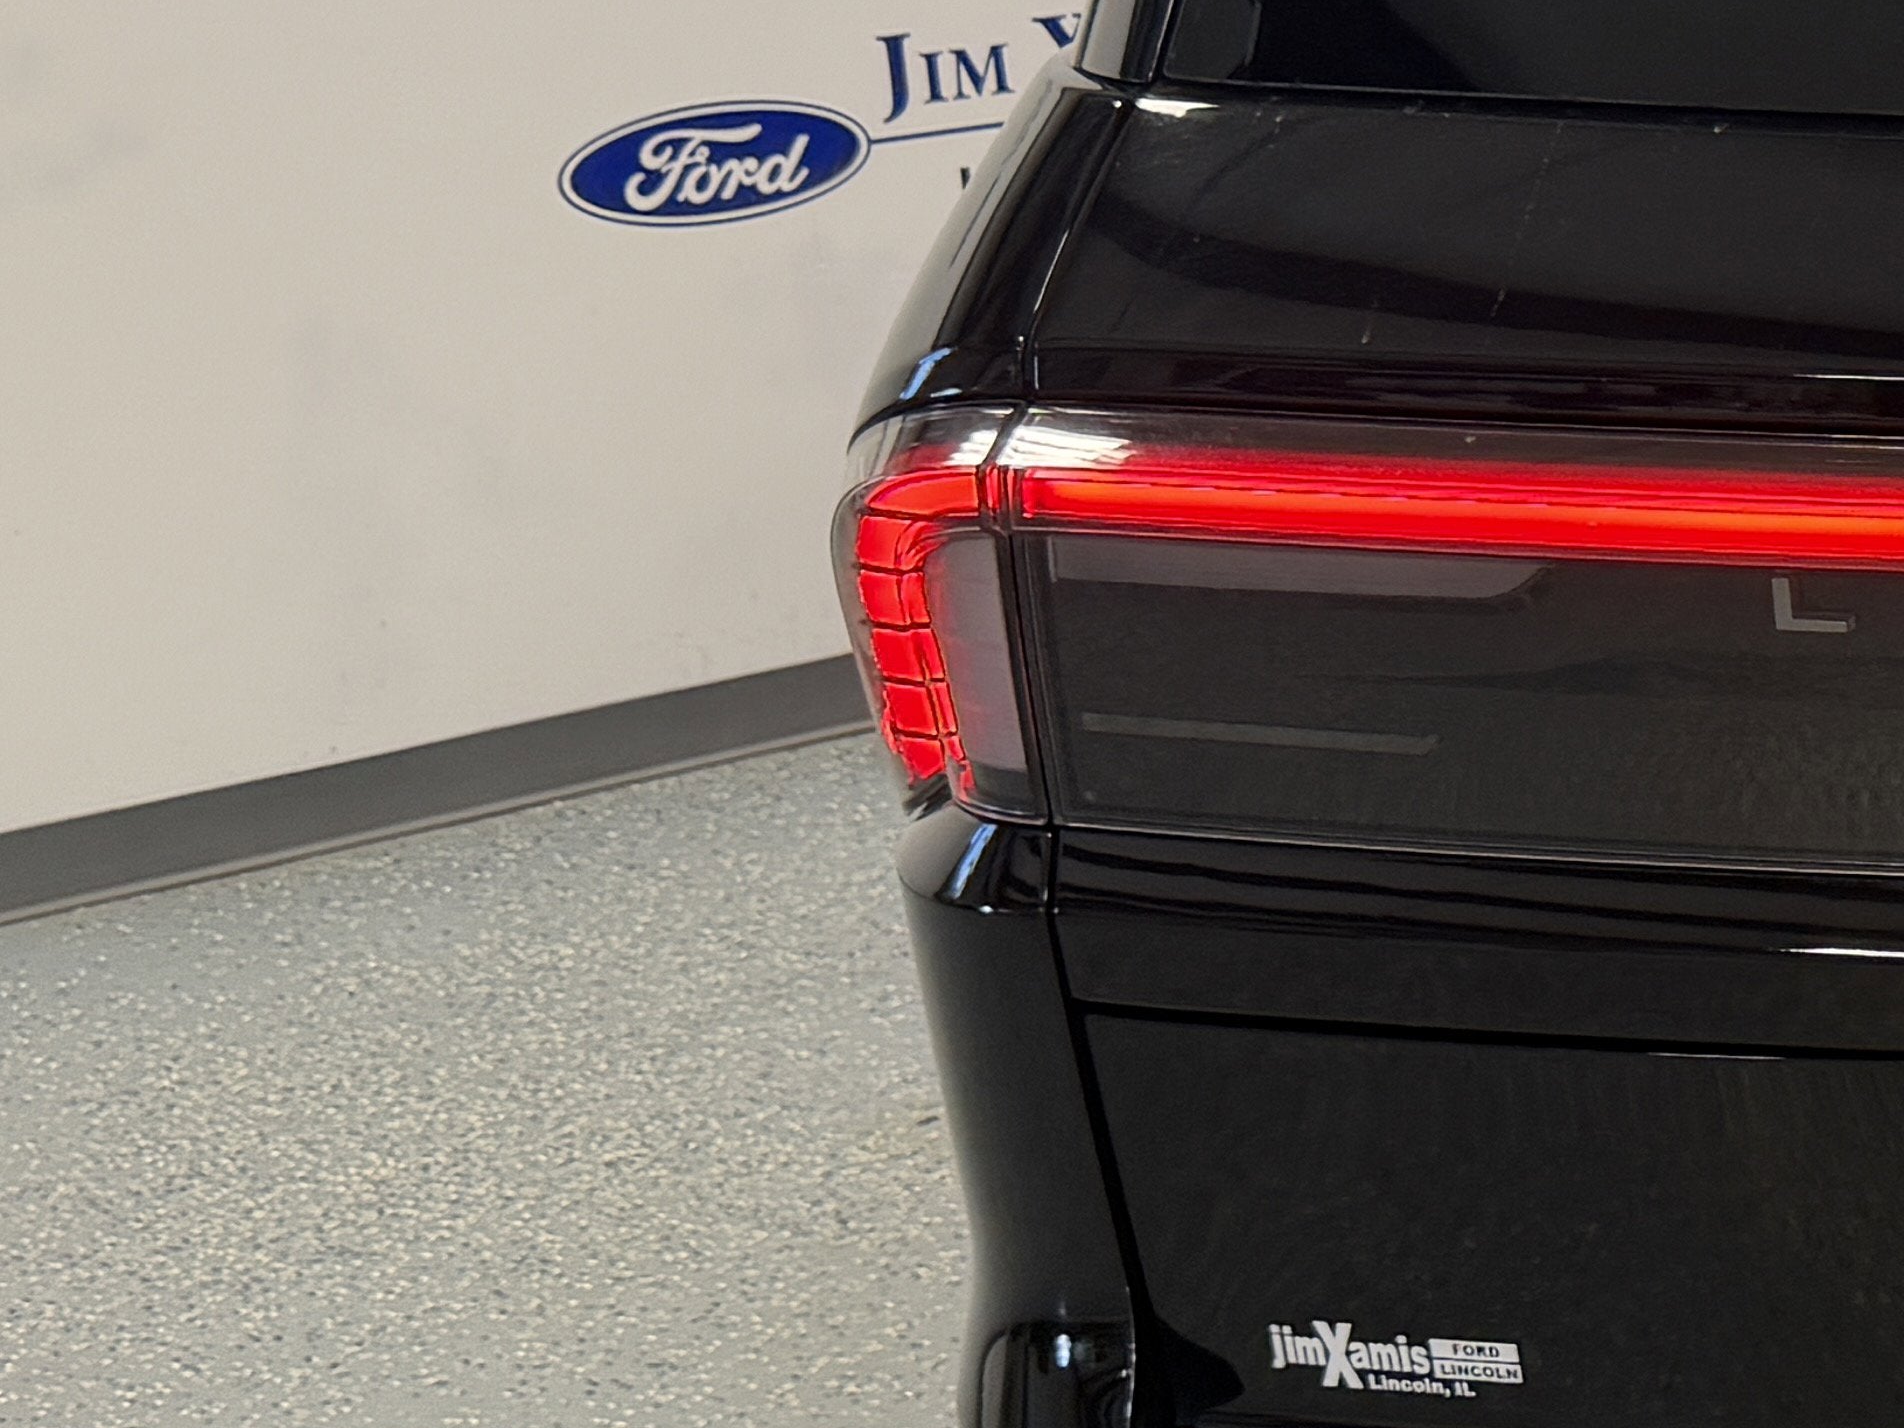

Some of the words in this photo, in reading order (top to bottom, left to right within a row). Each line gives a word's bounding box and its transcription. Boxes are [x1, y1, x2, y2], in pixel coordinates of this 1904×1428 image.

[875, 33, 1015, 124] JIM
[623, 122, 810, 212] Ford
[1452, 1343, 1501, 1358] FORD
[1440, 1363, 1520, 1381] LINCOLN
[1367, 1373, 1451, 1398] Lincoln,
[1454, 1381, 1477, 1397] IL
